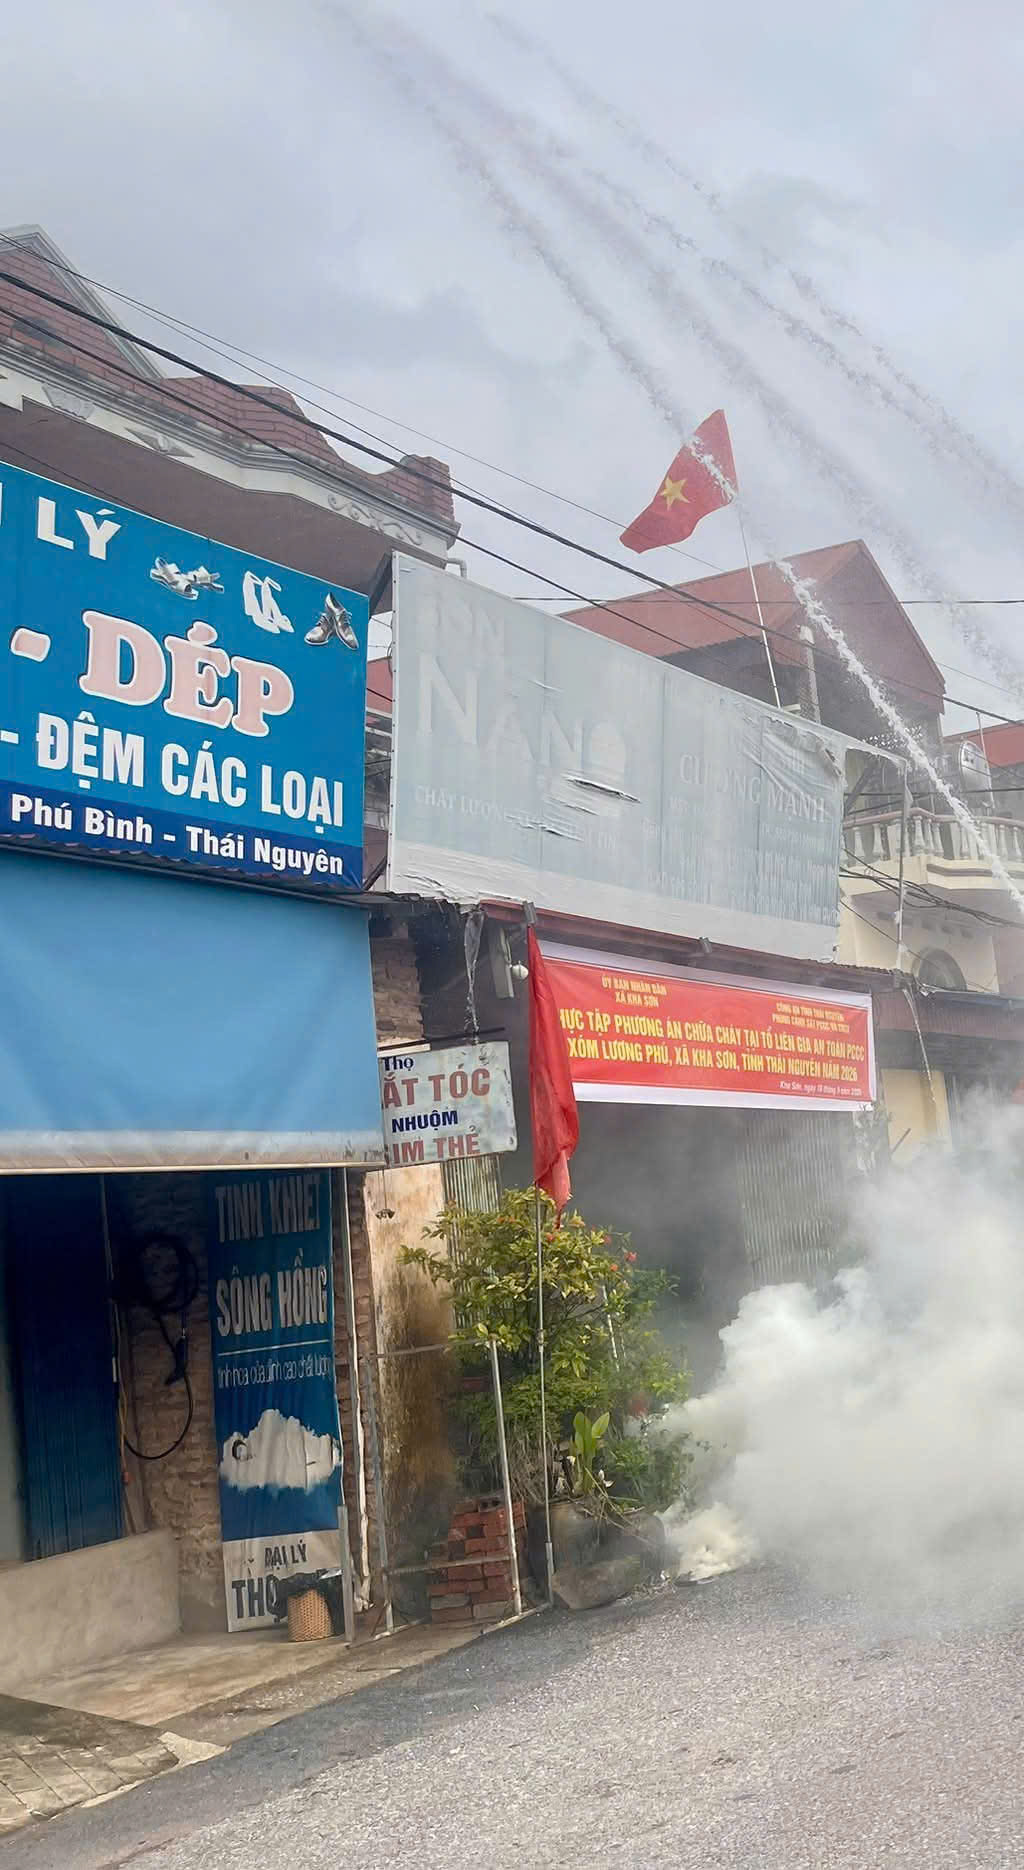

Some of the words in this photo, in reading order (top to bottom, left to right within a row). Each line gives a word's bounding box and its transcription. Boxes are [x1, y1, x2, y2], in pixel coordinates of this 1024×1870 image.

[37, 496, 122, 560] LÝ
[78, 609, 294, 737] DÉP
[36, 711, 145, 789] ĐỆM
[161, 741, 247, 807] CÁC
[261, 764, 343, 834] LOẠI
[11, 793, 72, 831] Phú
[85, 807, 153, 844] Bình
[186, 825, 244, 860] Thái
[254, 843, 343, 875] Nguyên
[560, 1008, 584, 1034] HỰC
[586, 1009, 611, 1036] TẬP
[614, 1013, 664, 1038] PHƯƠNG
[667, 1016, 682, 1041] ÁN
[382, 1056, 414, 1071] Thọ
[567, 1035, 599, 1059] XÓM
[601, 1039, 643, 1062] LƯƠNG
[674, 1044, 690, 1066] XÃ
[692, 1049, 714, 1068] KHA
[384, 1072, 419, 1108] ẮT
[428, 1063, 490, 1102] TÓC
[391, 1110, 459, 1133] NHUỘM
[392, 1140, 425, 1165] IM
[433, 1125, 481, 1159] THẺ
[216, 1265, 272, 1337] SÔNG
[277, 1248, 328, 1328] HỒNG
[290, 1539, 307, 1563] LÝ
